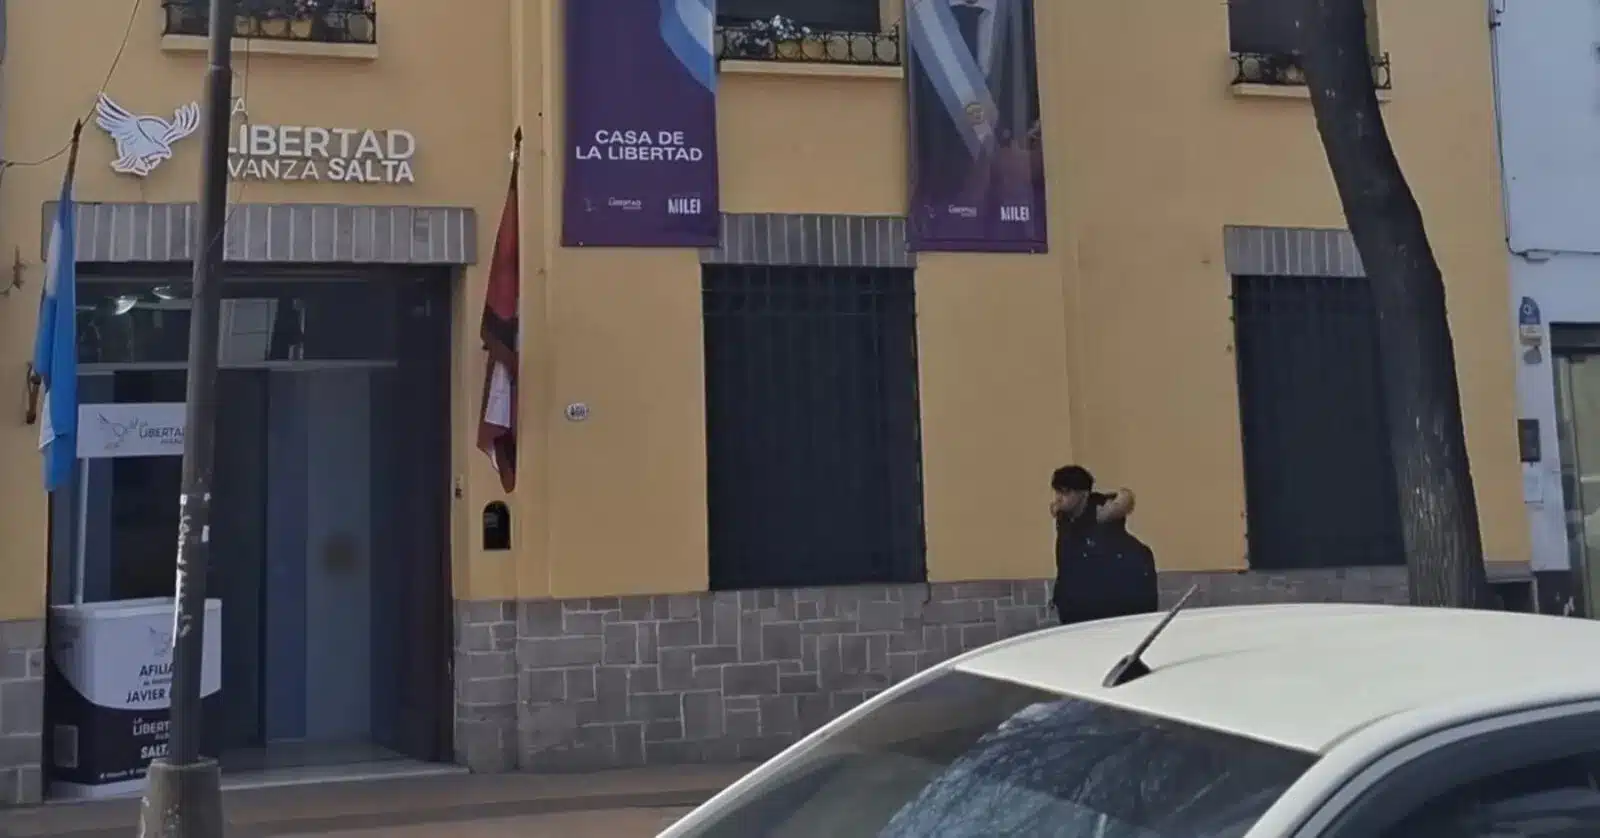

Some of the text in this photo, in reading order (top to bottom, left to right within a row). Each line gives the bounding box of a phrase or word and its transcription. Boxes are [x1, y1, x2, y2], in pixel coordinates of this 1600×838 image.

[595, 130, 684, 145] CASA DE
[576, 146, 703, 161] LA LIBERTAD
[227, 158, 415, 182] VANZA SALTA
[668, 198, 701, 214] MILEI
[1001, 206, 1029, 221] MILEI
[139, 427, 185, 438] LIBERTA
[126, 688, 165, 703] JAVIER
[132, 720, 171, 735] LIBERT
[141, 744, 169, 759] SALT
